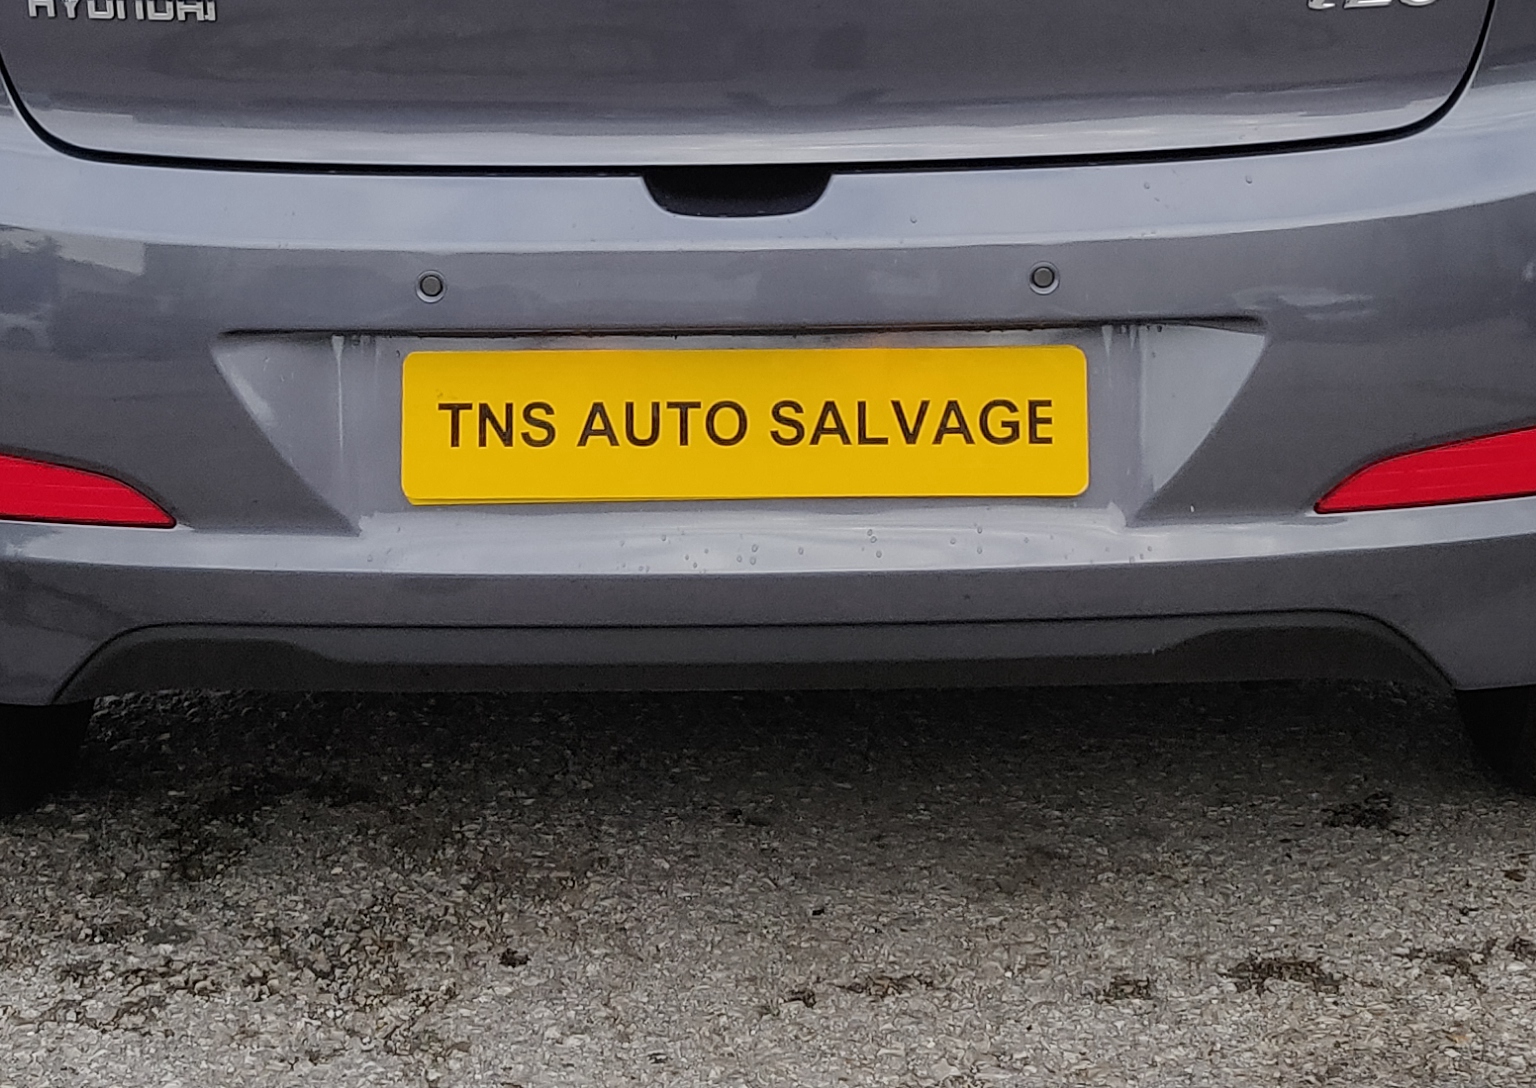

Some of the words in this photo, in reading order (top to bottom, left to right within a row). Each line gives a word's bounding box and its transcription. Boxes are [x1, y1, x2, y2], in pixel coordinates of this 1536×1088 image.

[438, 401, 557, 448] TNS
[577, 400, 749, 448] AUTO
[769, 398, 1054, 447] SALVAGE
